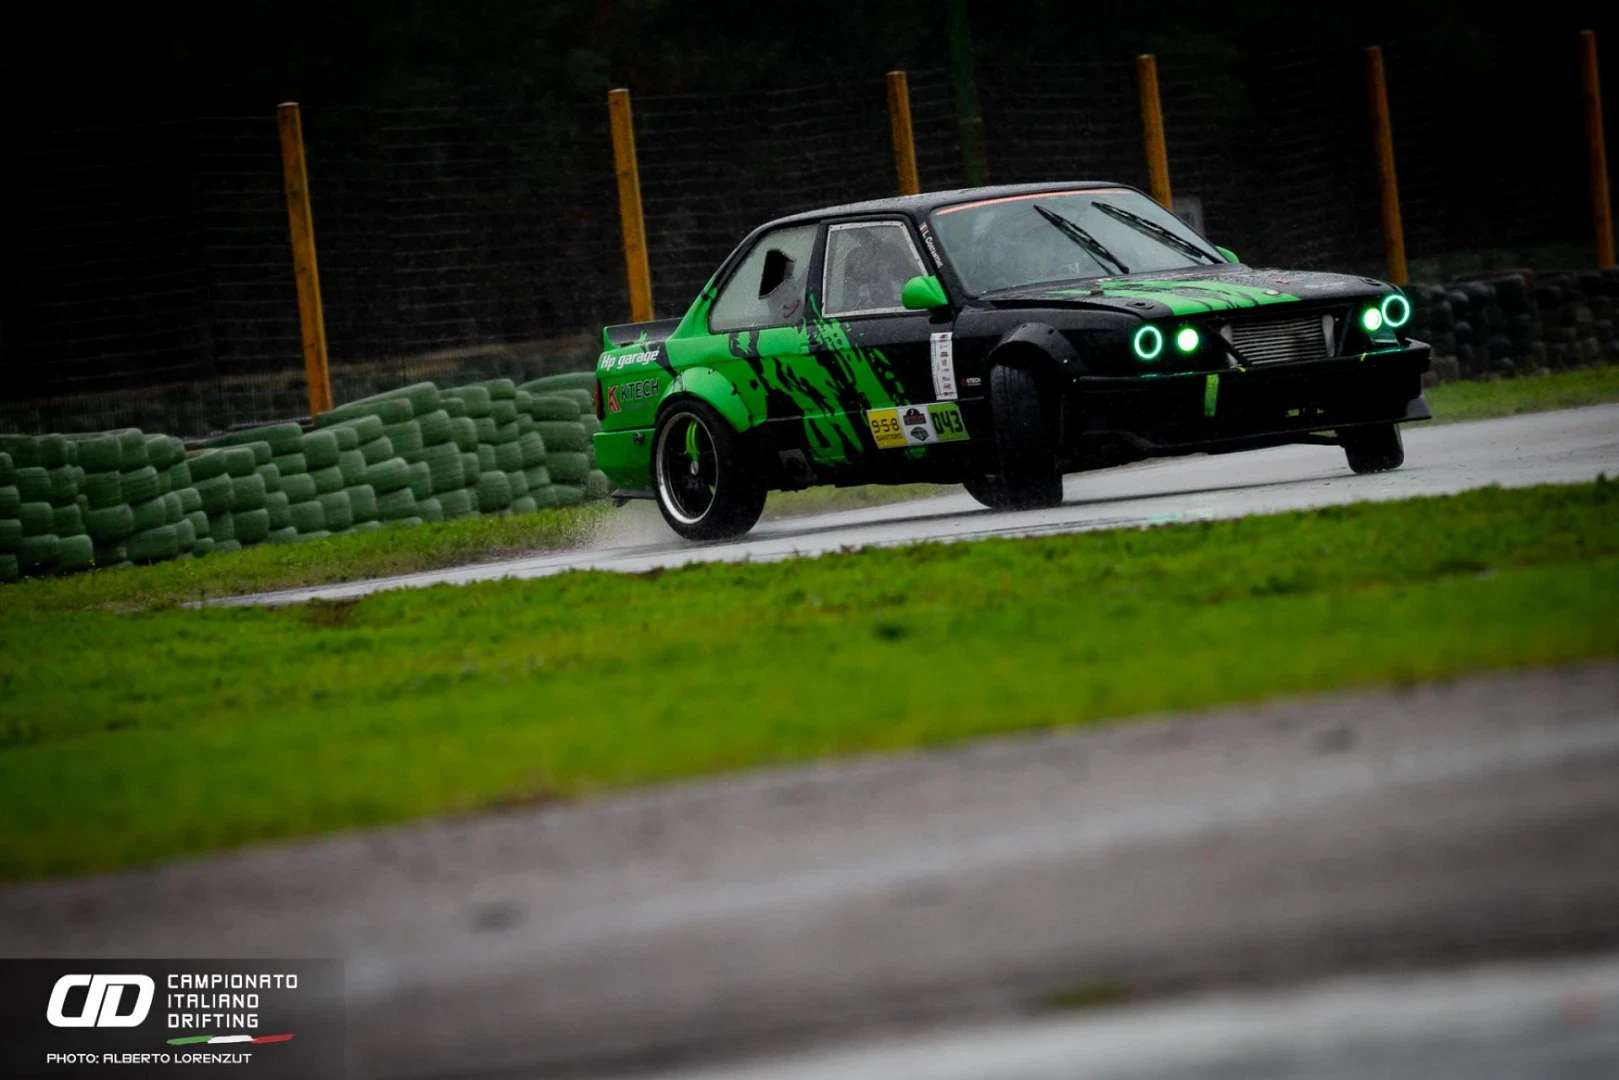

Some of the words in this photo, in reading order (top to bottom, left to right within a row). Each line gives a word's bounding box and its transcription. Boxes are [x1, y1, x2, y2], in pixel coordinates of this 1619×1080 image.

[601, 354, 616, 371] Hp
[617, 350, 660, 369] garage
[620, 378, 660, 402] KTECH
